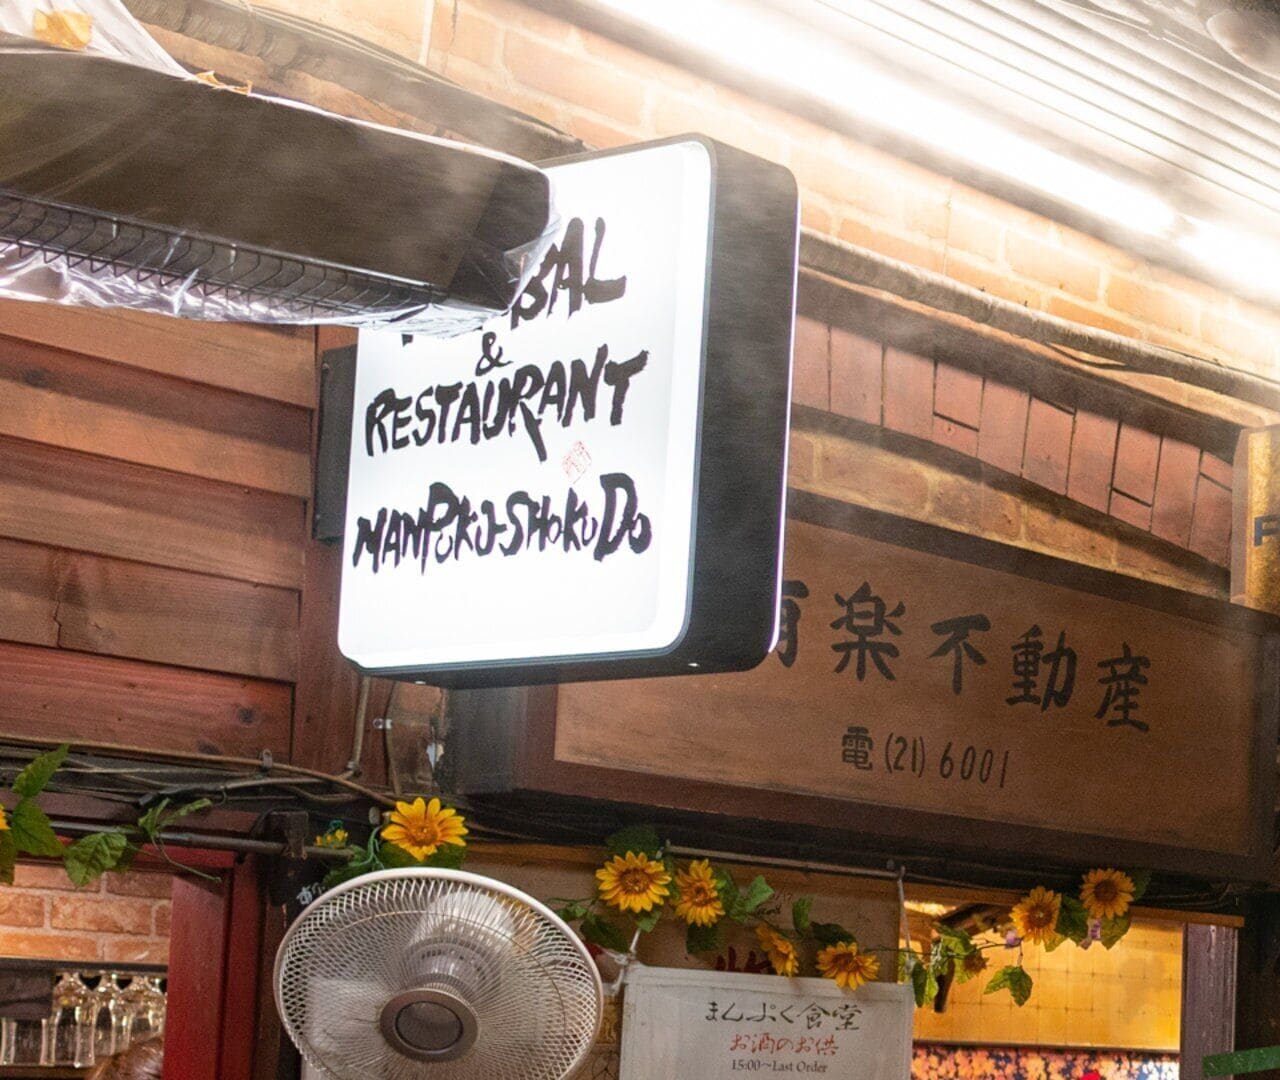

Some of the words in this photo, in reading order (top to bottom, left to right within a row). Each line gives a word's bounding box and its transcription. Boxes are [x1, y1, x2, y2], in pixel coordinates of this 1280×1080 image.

[475, 331, 514, 377] &
[364, 344, 650, 462] RESTAURANT
[705, 1000, 862, 1031] まんぷく食堂
[729, 1032, 840, 1056] お酒のお供
[796, 1060, 828, 1073] Order
